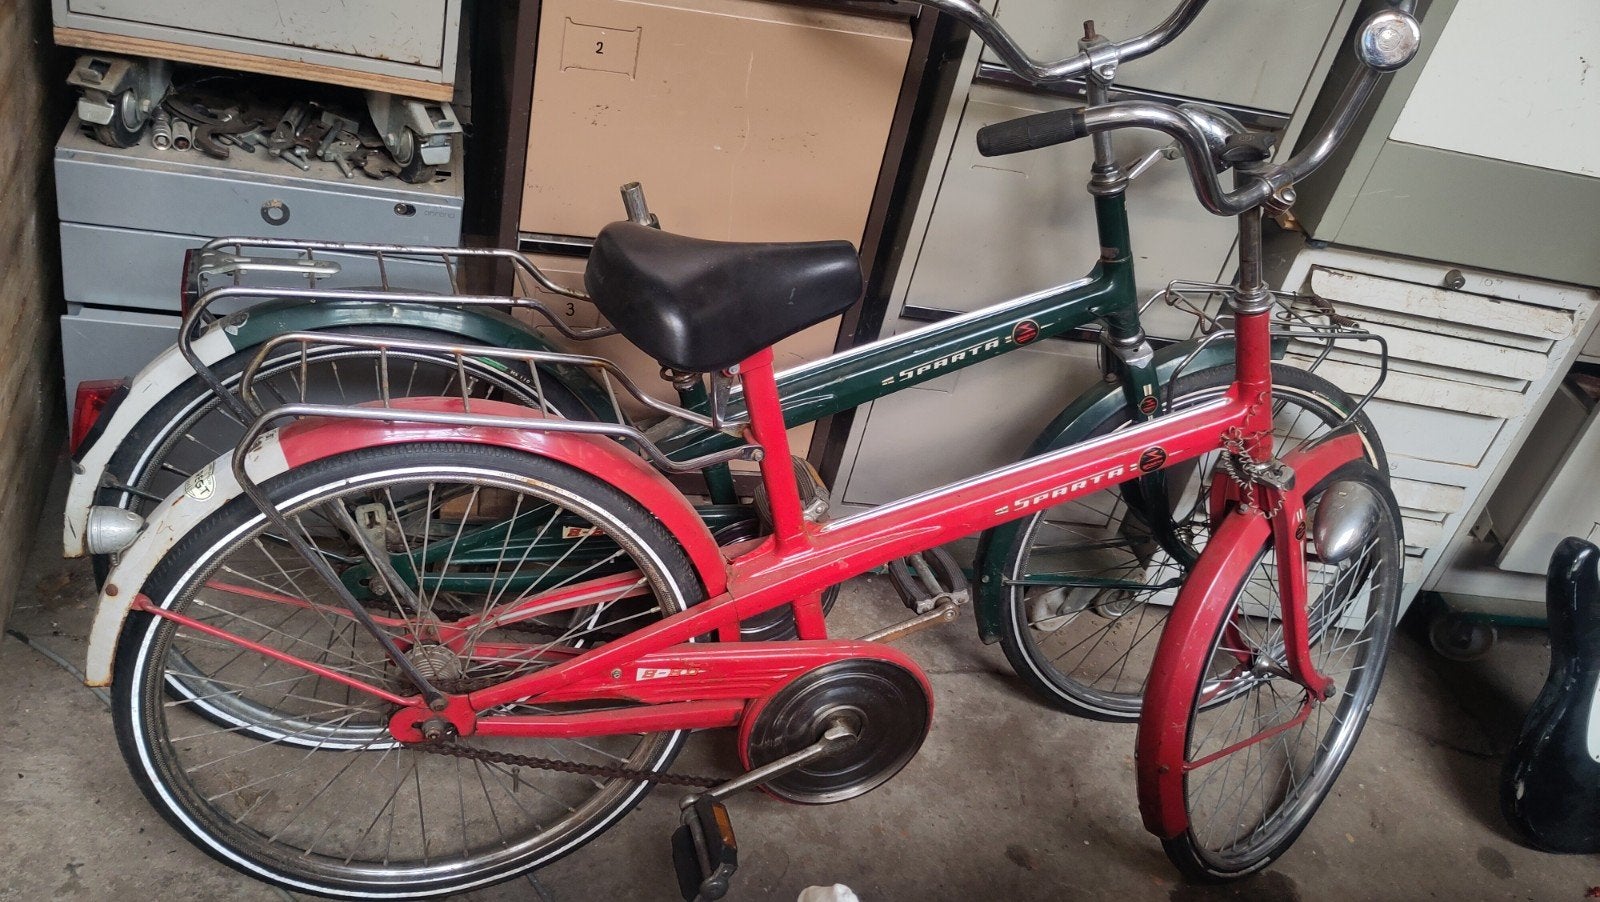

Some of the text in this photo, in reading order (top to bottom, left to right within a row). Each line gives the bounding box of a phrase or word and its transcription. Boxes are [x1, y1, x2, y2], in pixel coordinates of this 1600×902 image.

[595, 41, 604, 55] 2
[565, 302, 575, 317] 3
[899, 336, 1000, 382] SPARTA
[1013, 464, 1124, 511] SPARTA
